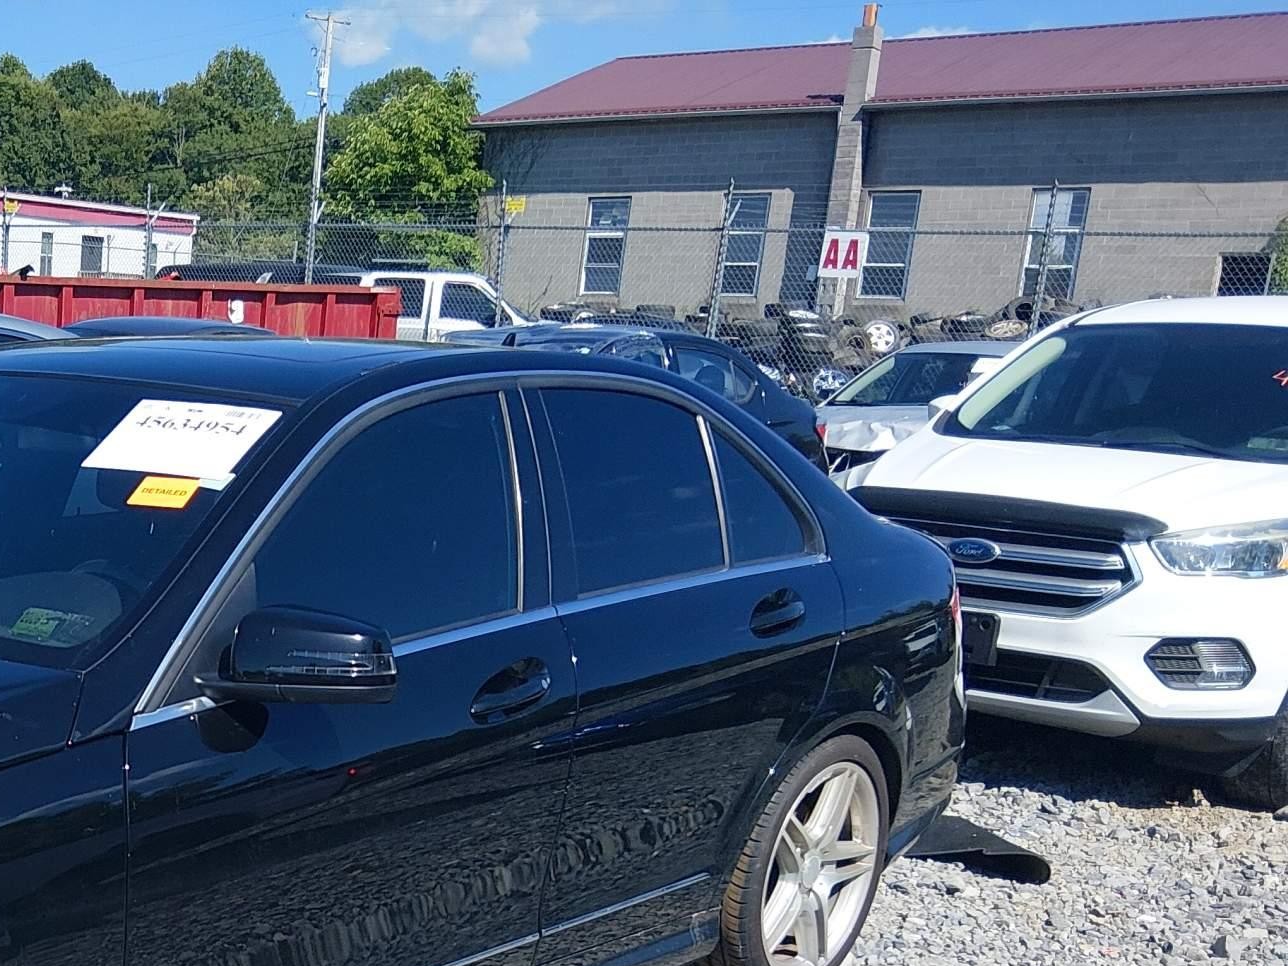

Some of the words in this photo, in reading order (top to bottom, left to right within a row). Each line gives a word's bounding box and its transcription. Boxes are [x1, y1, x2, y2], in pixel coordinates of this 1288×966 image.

[822, 238, 859, 269] AA
[136, 415, 247, 436] 45634954
[141, 486, 188, 497] DETAILED
[955, 543, 987, 556] Ford
